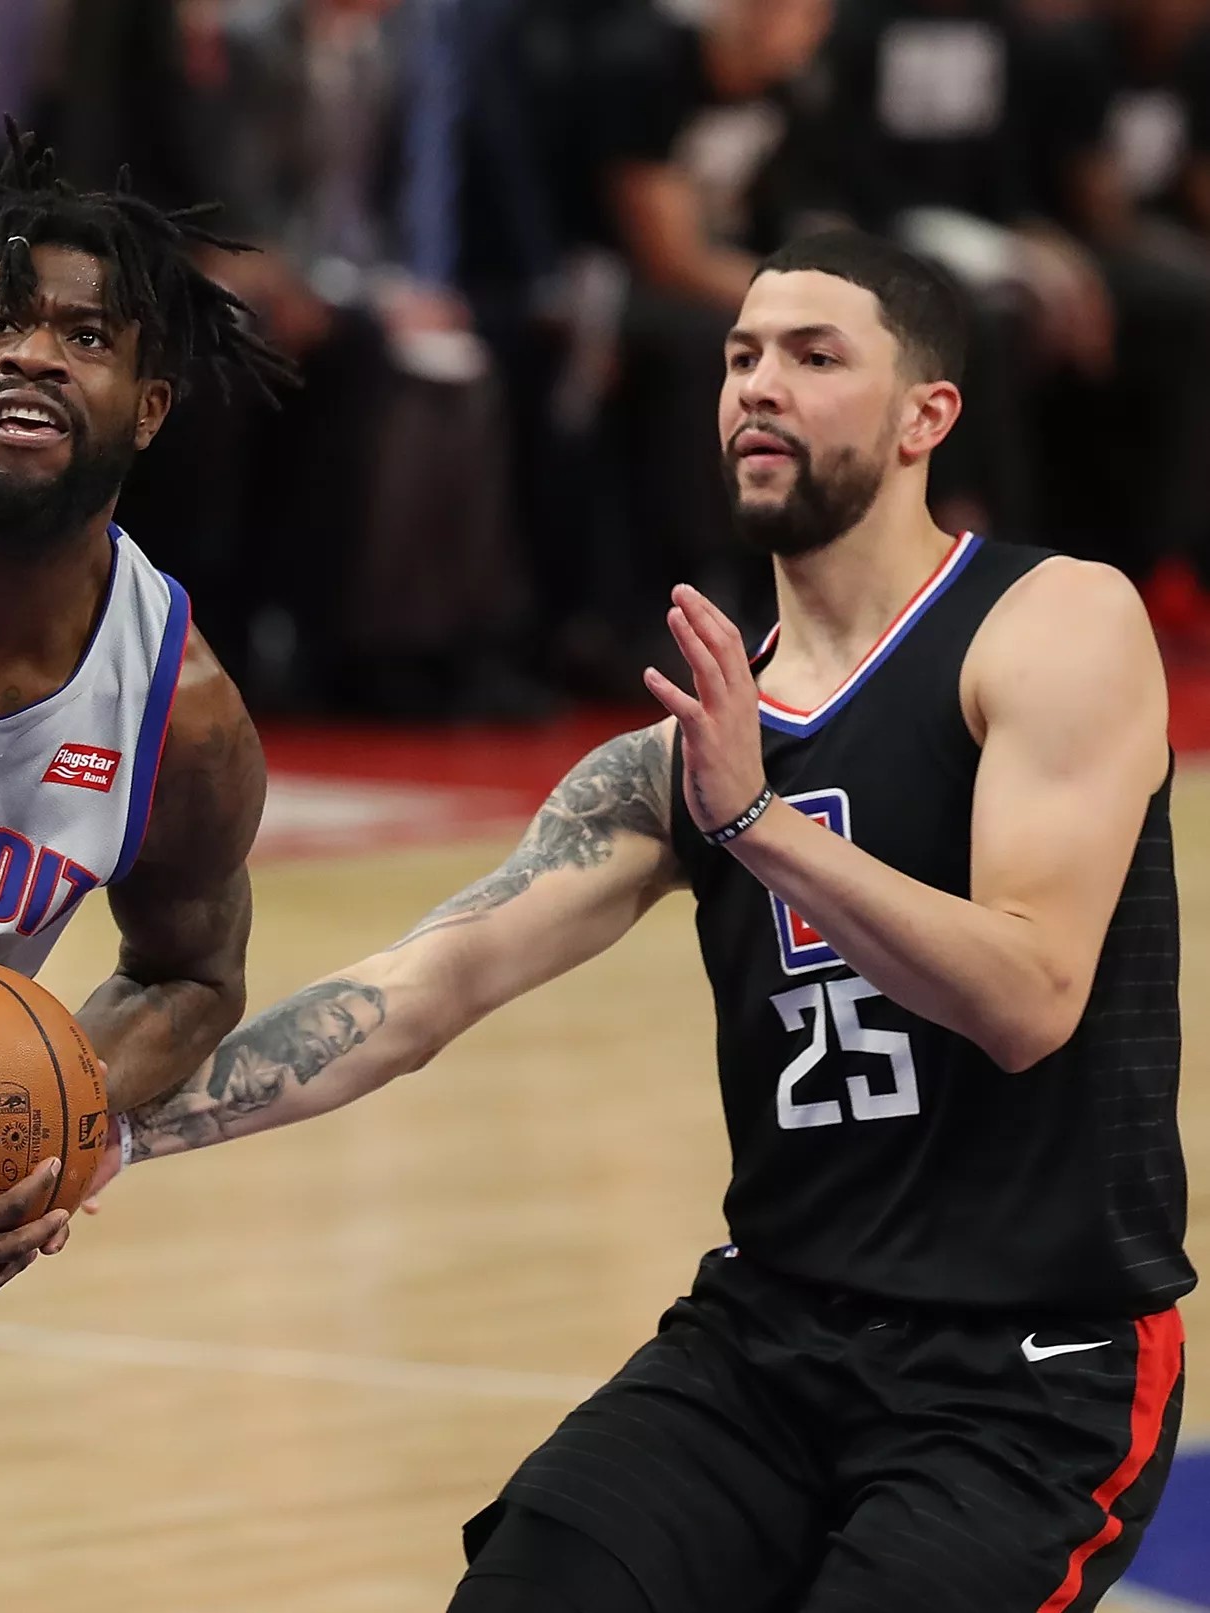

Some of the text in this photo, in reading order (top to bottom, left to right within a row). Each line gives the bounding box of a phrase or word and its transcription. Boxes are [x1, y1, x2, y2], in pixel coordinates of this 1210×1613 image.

[54, 749, 115, 771] Flagstar
[83, 772, 109, 785] Bank
[769, 976, 920, 1130] 25
